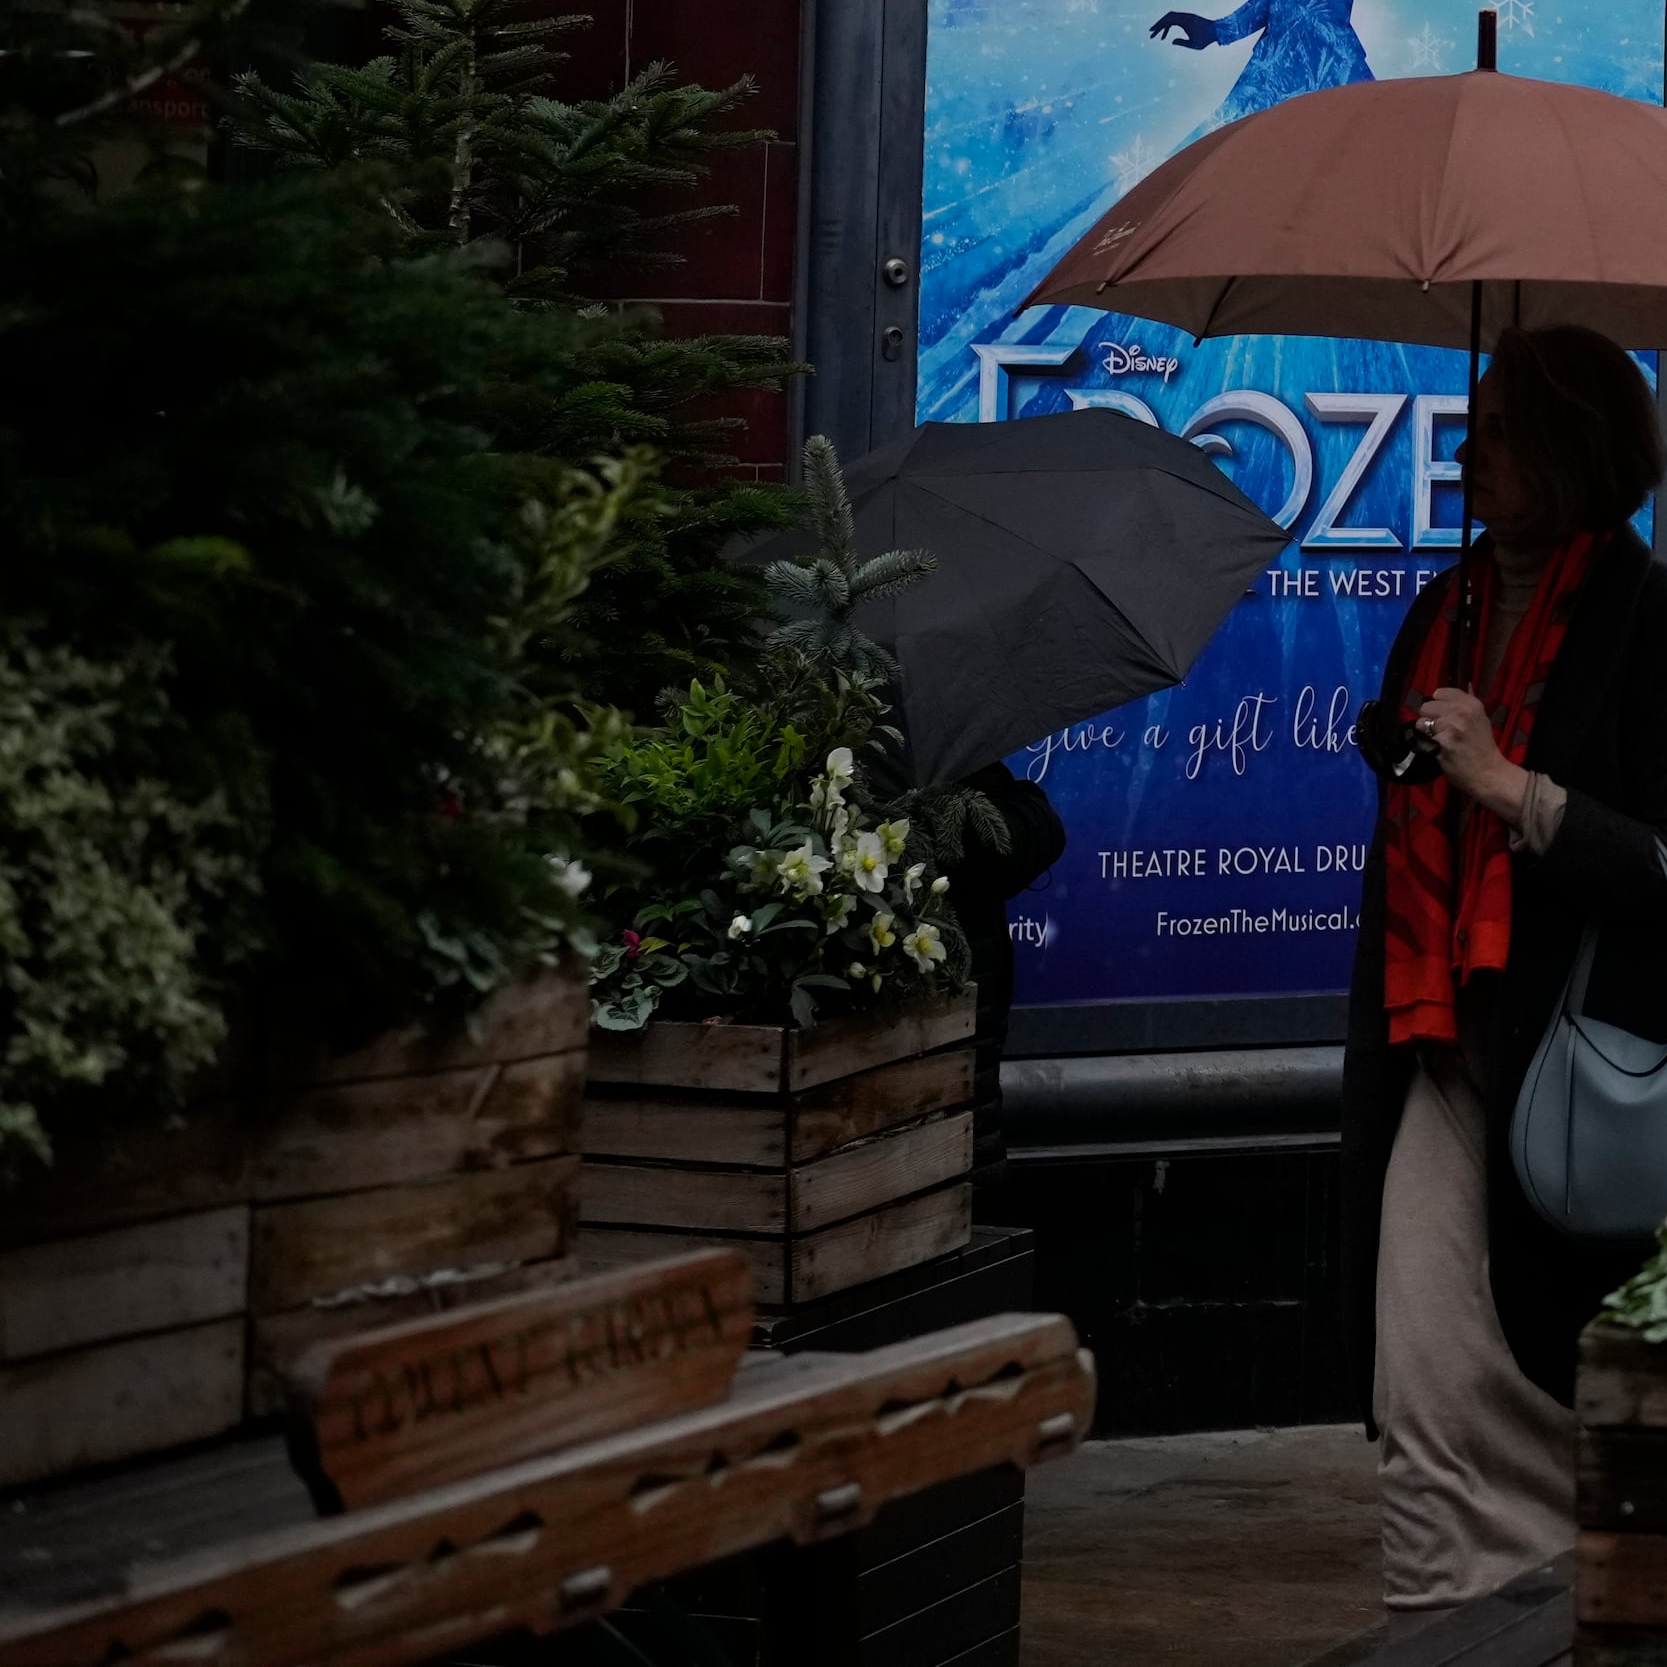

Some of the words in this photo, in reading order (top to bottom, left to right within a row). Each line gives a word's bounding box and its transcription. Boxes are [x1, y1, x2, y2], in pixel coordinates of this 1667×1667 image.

[1266, 568, 1320, 597] THE
[1328, 568, 1406, 597] WEST
[1143, 722, 1170, 750] a
[1185, 691, 1278, 780] gift
[1293, 685, 1358, 754] like
[1097, 847, 1208, 879] THEATRE
[1218, 846, 1306, 876] ROYAL
[1316, 843, 1367, 873] DRU
[1008, 913, 1048, 949] rity
